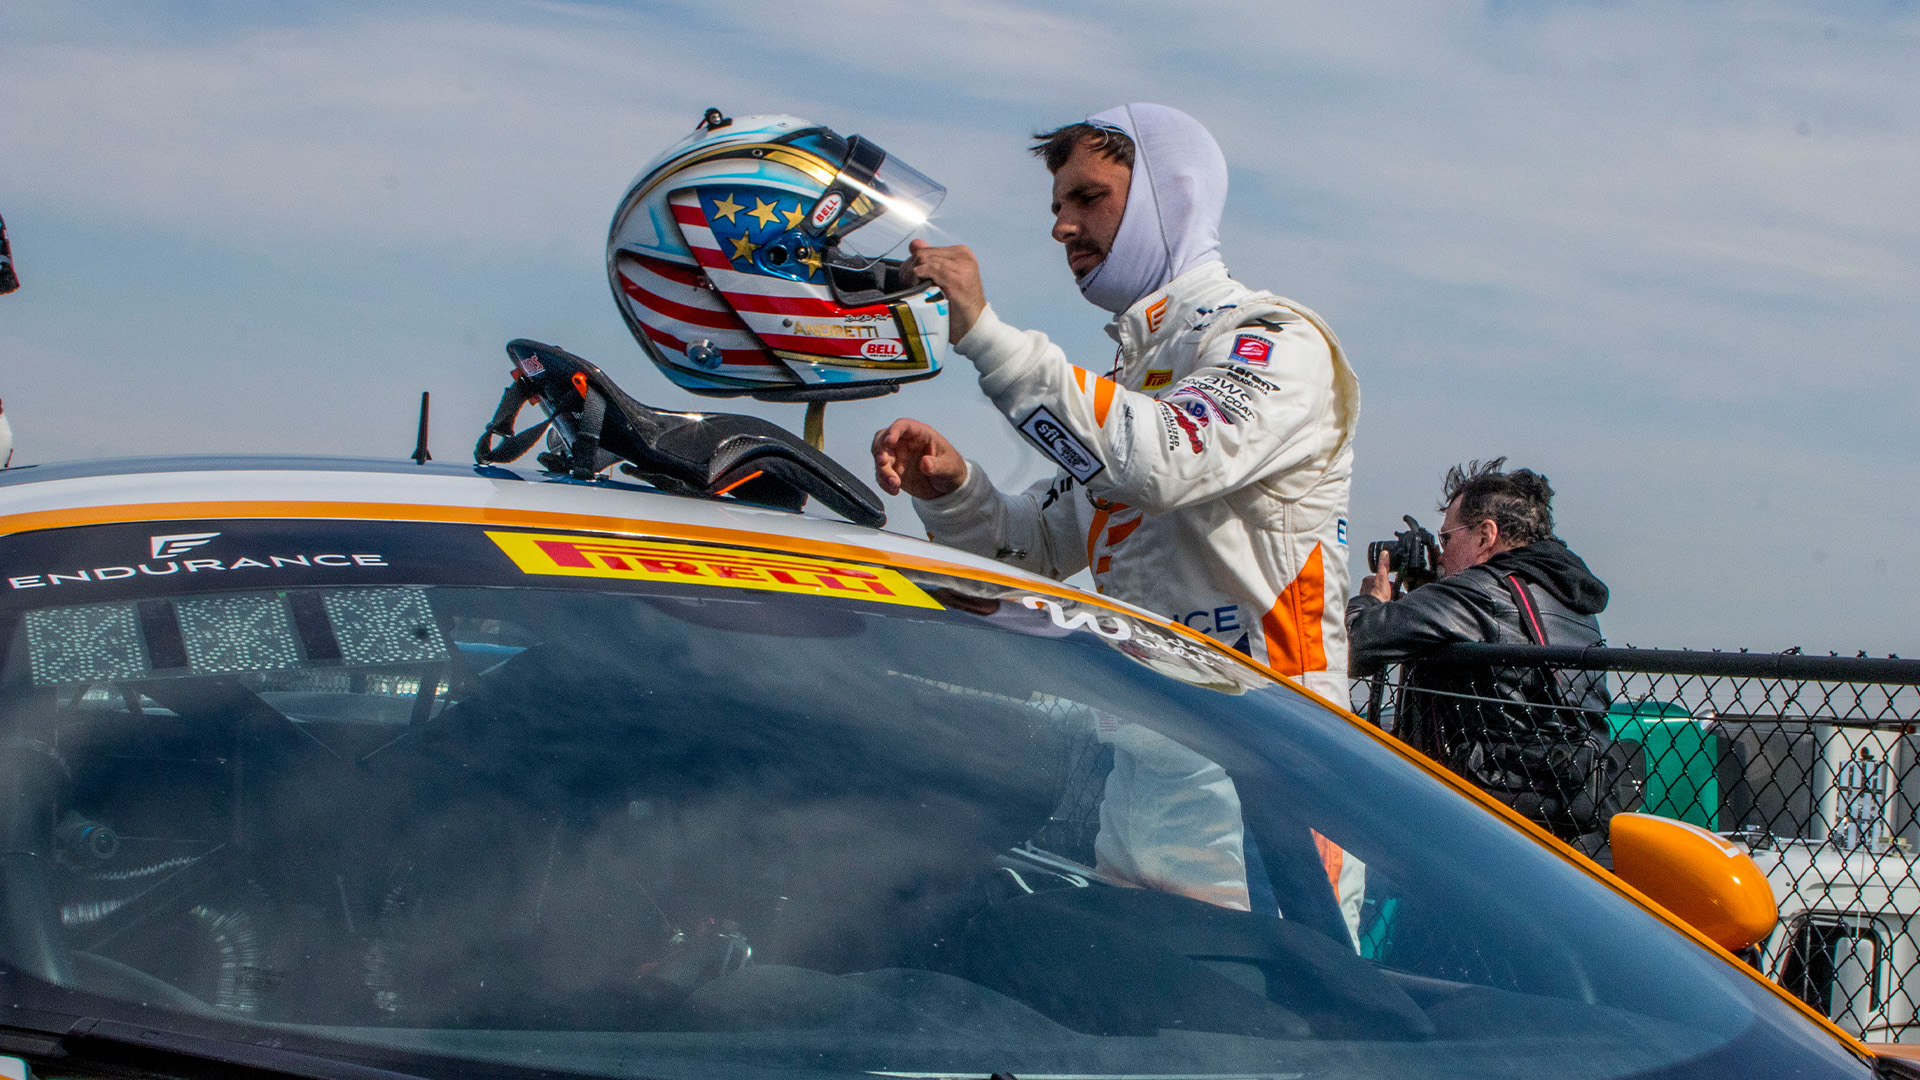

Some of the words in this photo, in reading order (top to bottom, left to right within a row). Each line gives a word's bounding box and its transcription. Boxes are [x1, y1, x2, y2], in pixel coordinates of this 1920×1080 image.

[815, 199, 839, 223] BELL
[793, 320, 879, 338] ANDRETTI
[866, 343, 898, 355] BELL
[1226, 371, 1268, 396] PHILADELPHIA
[1038, 423, 1060, 442] sfi
[8, 554, 389, 590] ENDURANCE
[532, 539, 898, 597] PIRELLI
